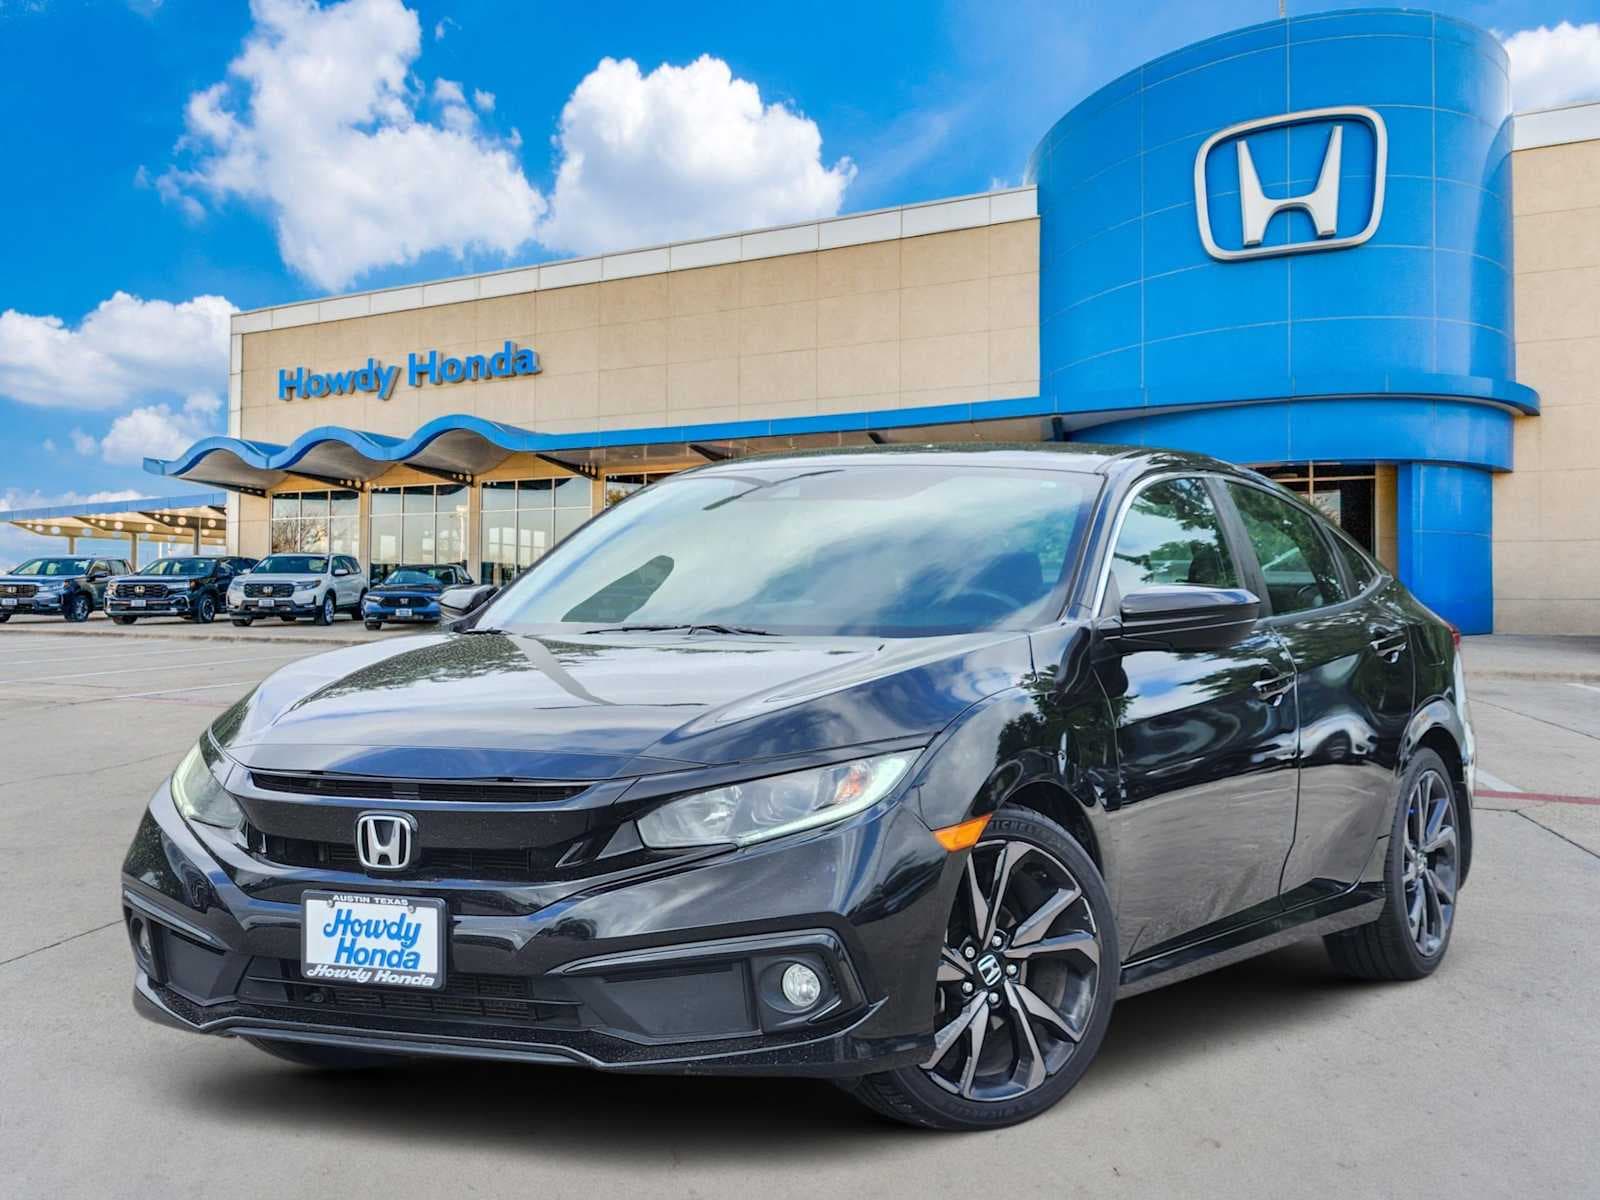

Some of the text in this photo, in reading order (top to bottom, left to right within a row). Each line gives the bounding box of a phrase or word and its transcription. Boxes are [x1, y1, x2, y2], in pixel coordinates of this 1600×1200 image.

[278, 340, 542, 400] Howdy Honda
[332, 894, 409, 906] AUSTIN TEXAS
[323, 908, 422, 949] Howdy
[334, 937, 421, 970] Honda
[306, 964, 435, 986] Howdy Honda
